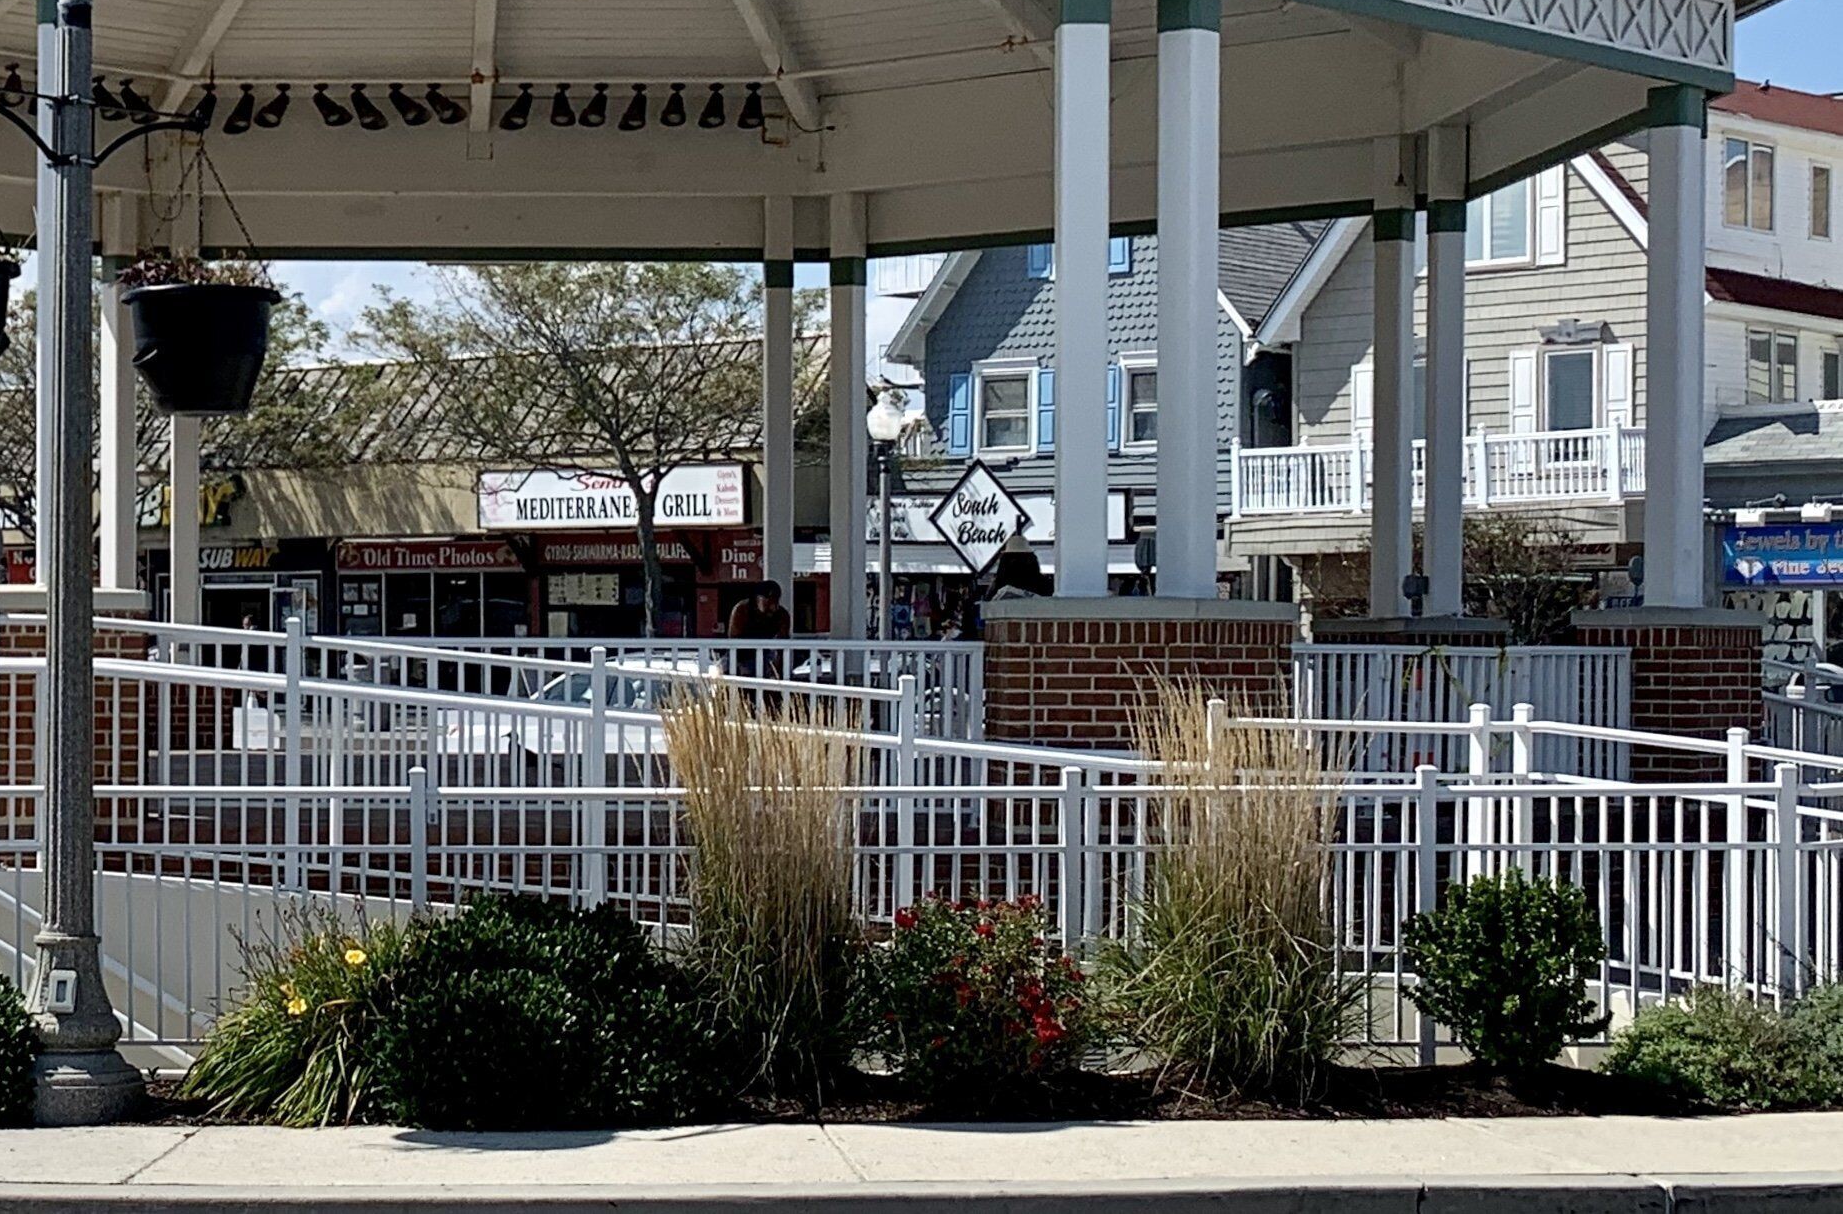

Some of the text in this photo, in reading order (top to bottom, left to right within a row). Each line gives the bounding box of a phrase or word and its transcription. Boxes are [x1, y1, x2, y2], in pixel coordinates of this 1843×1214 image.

[515, 493, 712, 521] MEDITERRANEA GRILL
[952, 492, 1000, 518] South
[957, 521, 1007, 547] Beach
[1734, 530, 1801, 552] Jewels
[1804, 528, 1830, 554] by
[198, 547, 279, 569] SUBWAY
[361, 546, 495, 567] Old Time Photos
[721, 548, 756, 564] Dine
[731, 564, 748, 580] In
